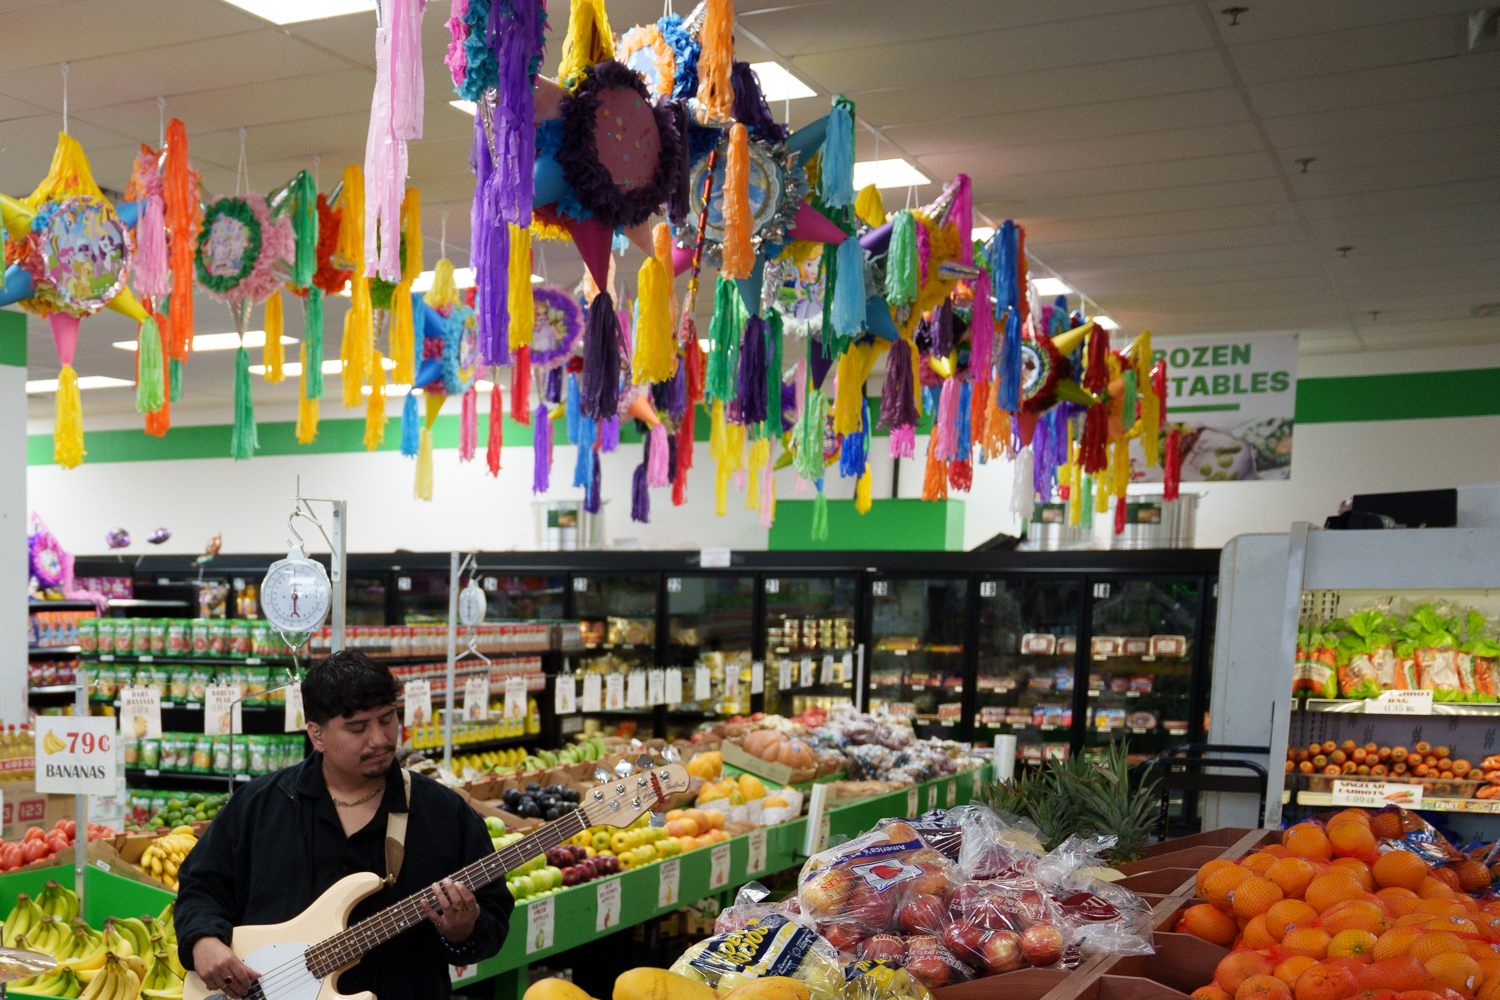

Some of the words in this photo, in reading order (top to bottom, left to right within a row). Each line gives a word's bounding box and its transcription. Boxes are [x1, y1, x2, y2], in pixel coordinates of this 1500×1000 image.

[1167, 370, 1290, 398] TABLES
[66, 731, 111, 755] 79¢
[45, 763, 106, 780] BANANAS
[19, 803, 43, 817] 123
